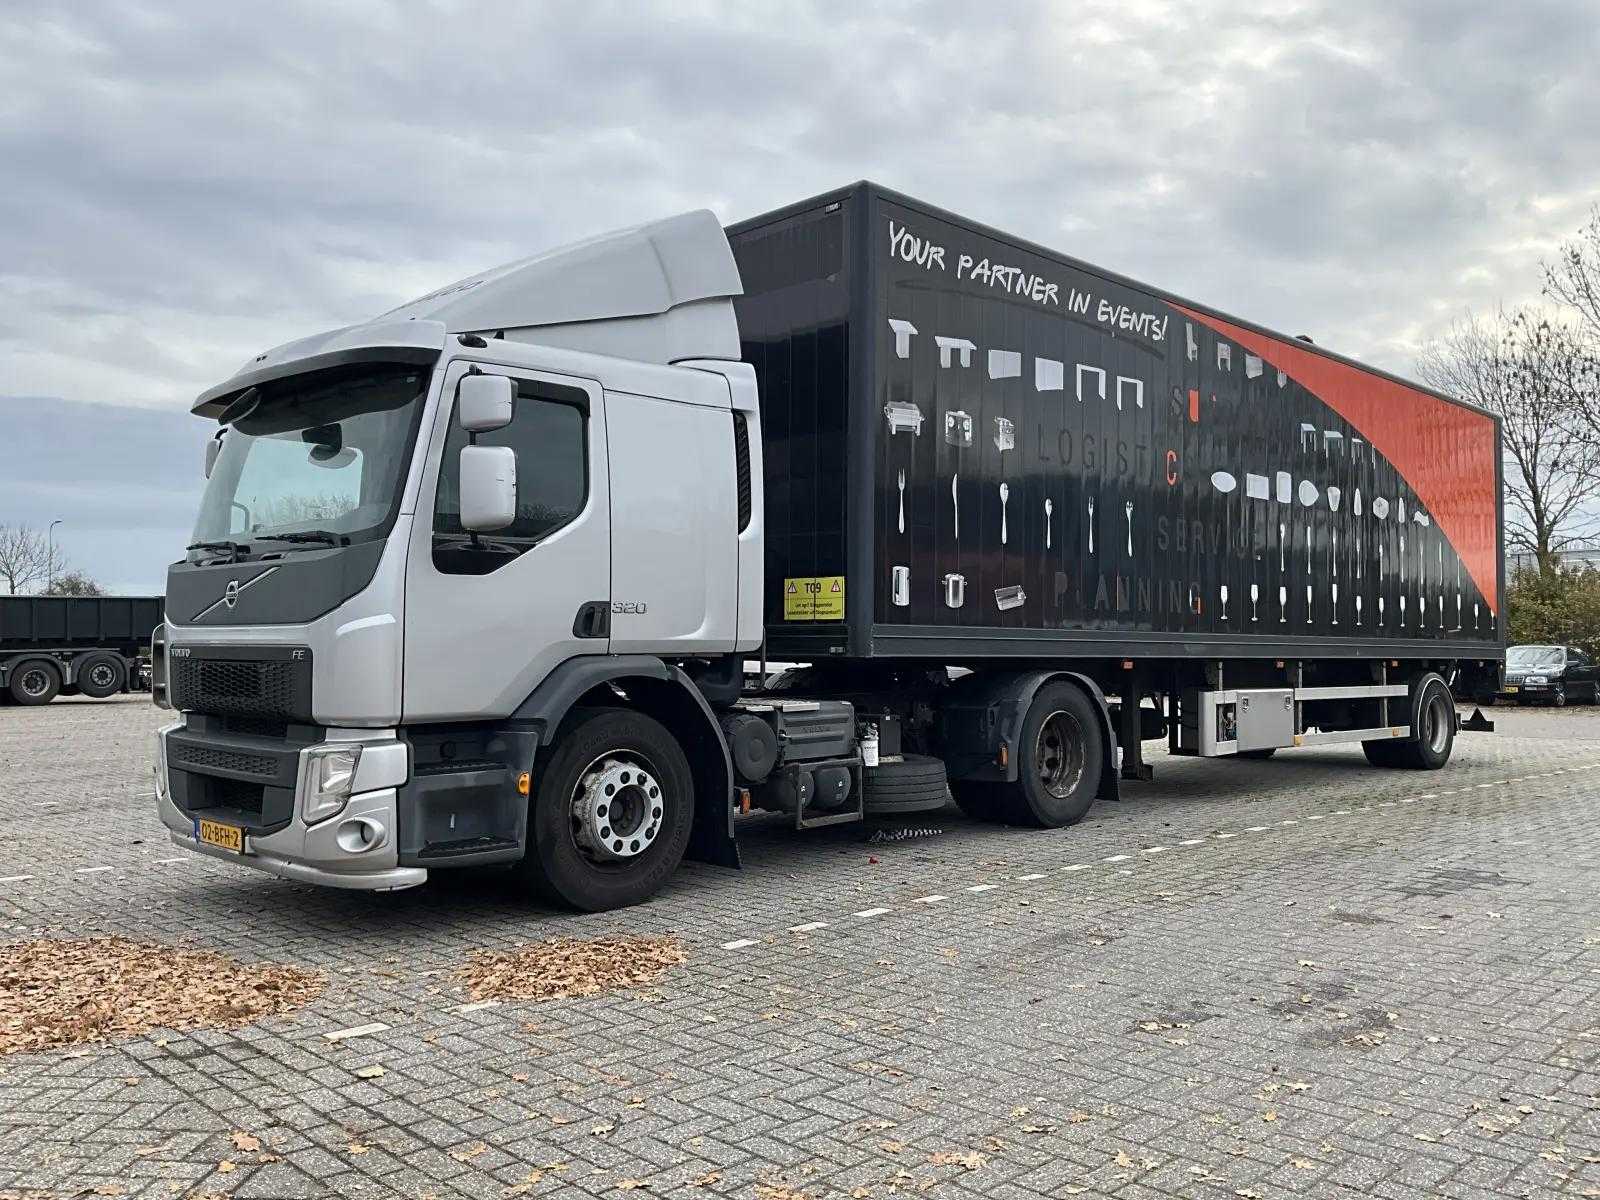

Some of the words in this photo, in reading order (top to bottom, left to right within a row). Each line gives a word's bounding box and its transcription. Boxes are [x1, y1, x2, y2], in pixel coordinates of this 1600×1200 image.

[888, 221, 945, 271] YOUR
[957, 254, 1059, 306] PARTNER
[1068, 289, 1091, 314] IN
[1097, 299, 1169, 340] EVENTS!
[804, 582, 822, 593] T09
[612, 601, 647, 614] 320
[292, 650, 305, 660] FE
[201, 822, 239, 847] 02-BFH-2
